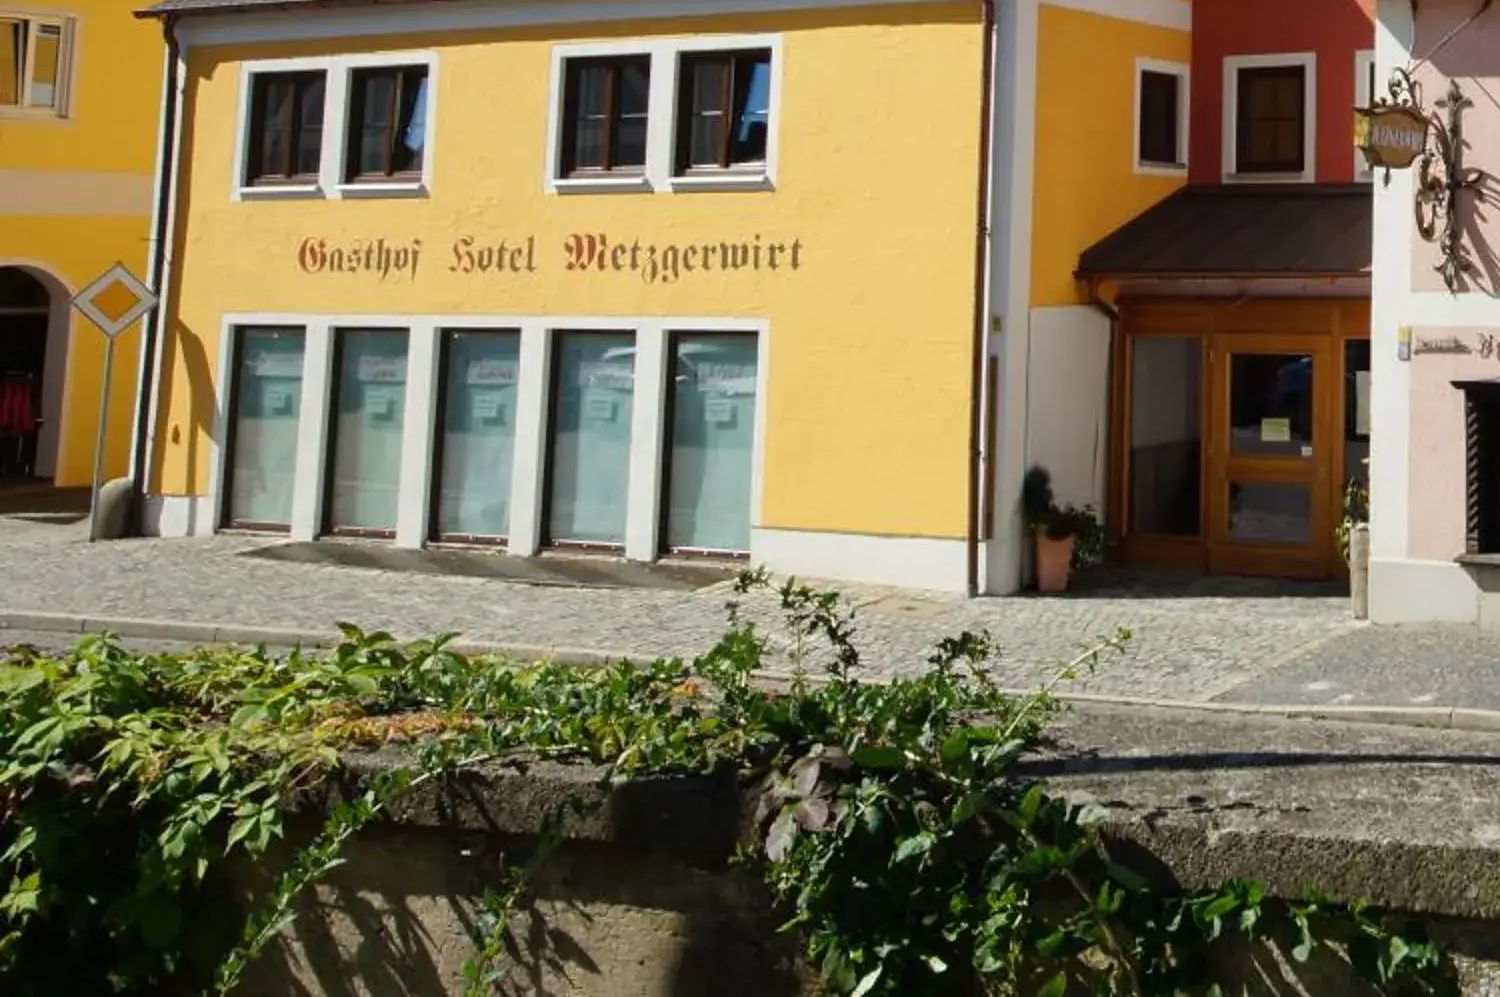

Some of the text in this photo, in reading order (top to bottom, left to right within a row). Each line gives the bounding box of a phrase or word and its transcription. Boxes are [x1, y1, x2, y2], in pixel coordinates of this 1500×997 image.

[299, 233, 803, 284] Gasthof Hotel Metzgerwirt
